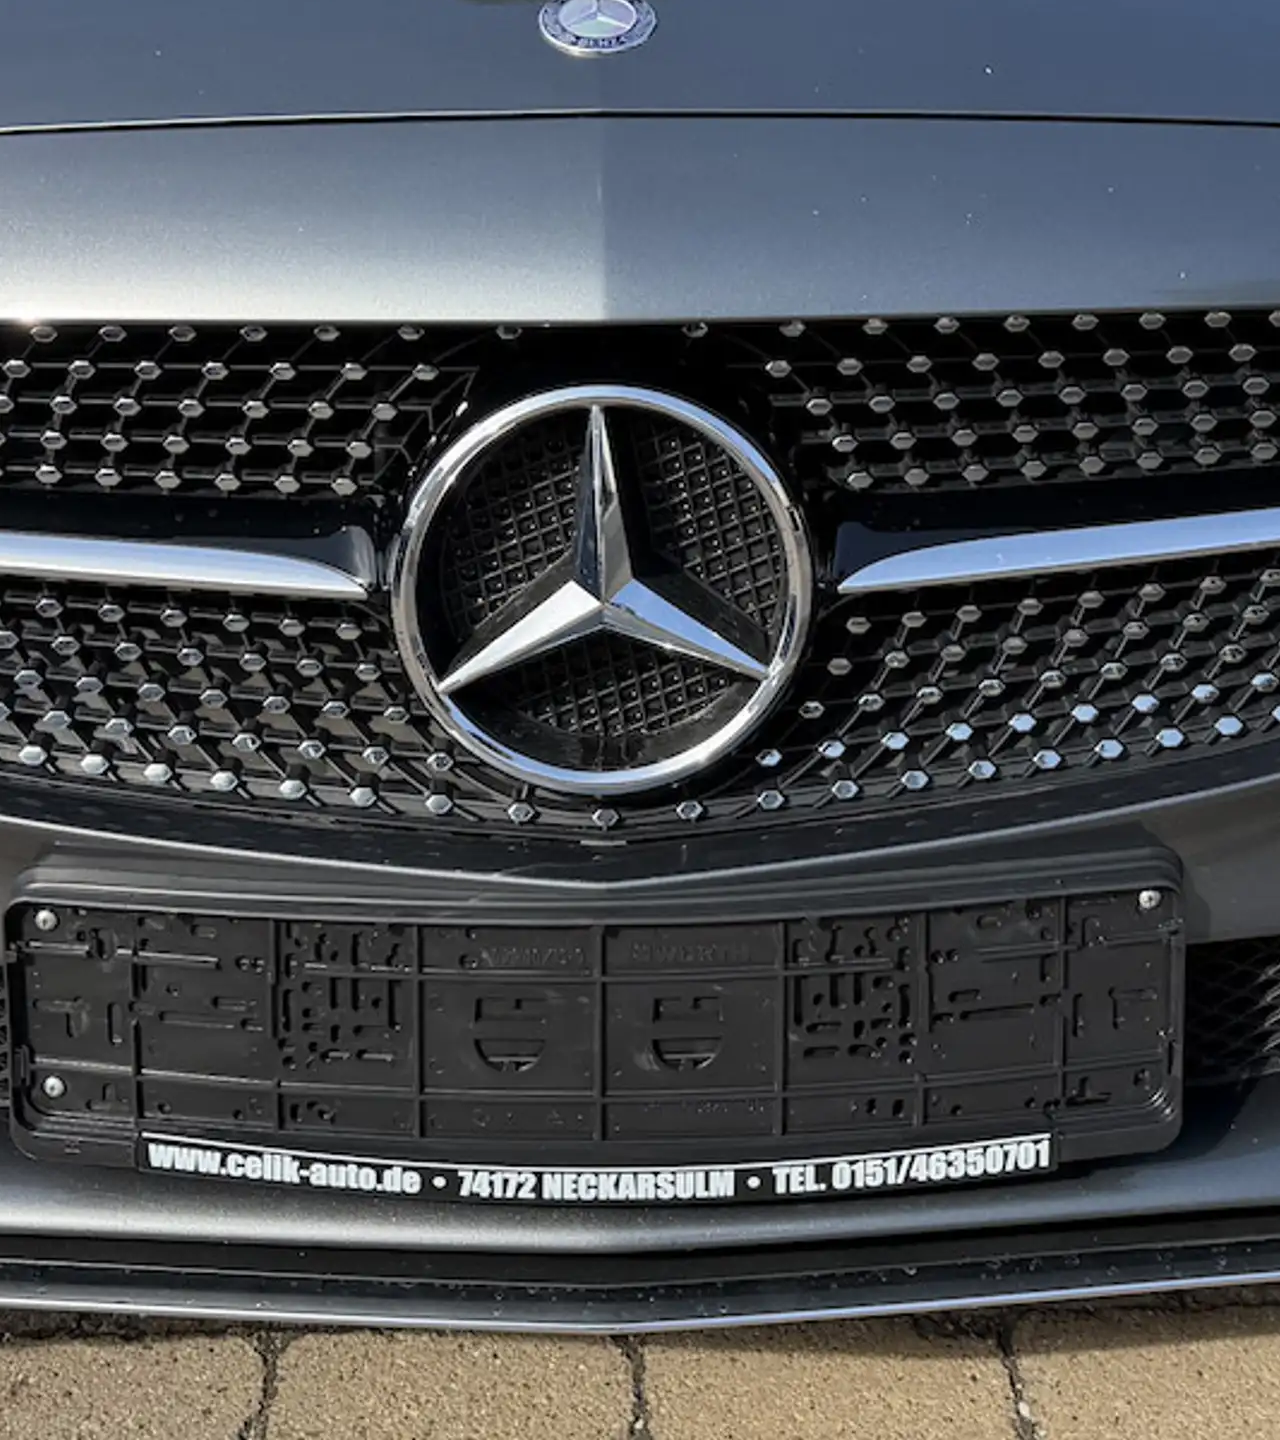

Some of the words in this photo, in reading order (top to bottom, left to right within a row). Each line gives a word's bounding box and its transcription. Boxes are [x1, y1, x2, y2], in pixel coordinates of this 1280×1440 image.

[148, 1143, 421, 1195] www.celik-auto.de
[458, 1170, 537, 1199] 74172
[541, 1171, 735, 1201] NECKARSULM
[772, 1164, 827, 1195] TEL.
[832, 1139, 1051, 1189] 0151/46350701
